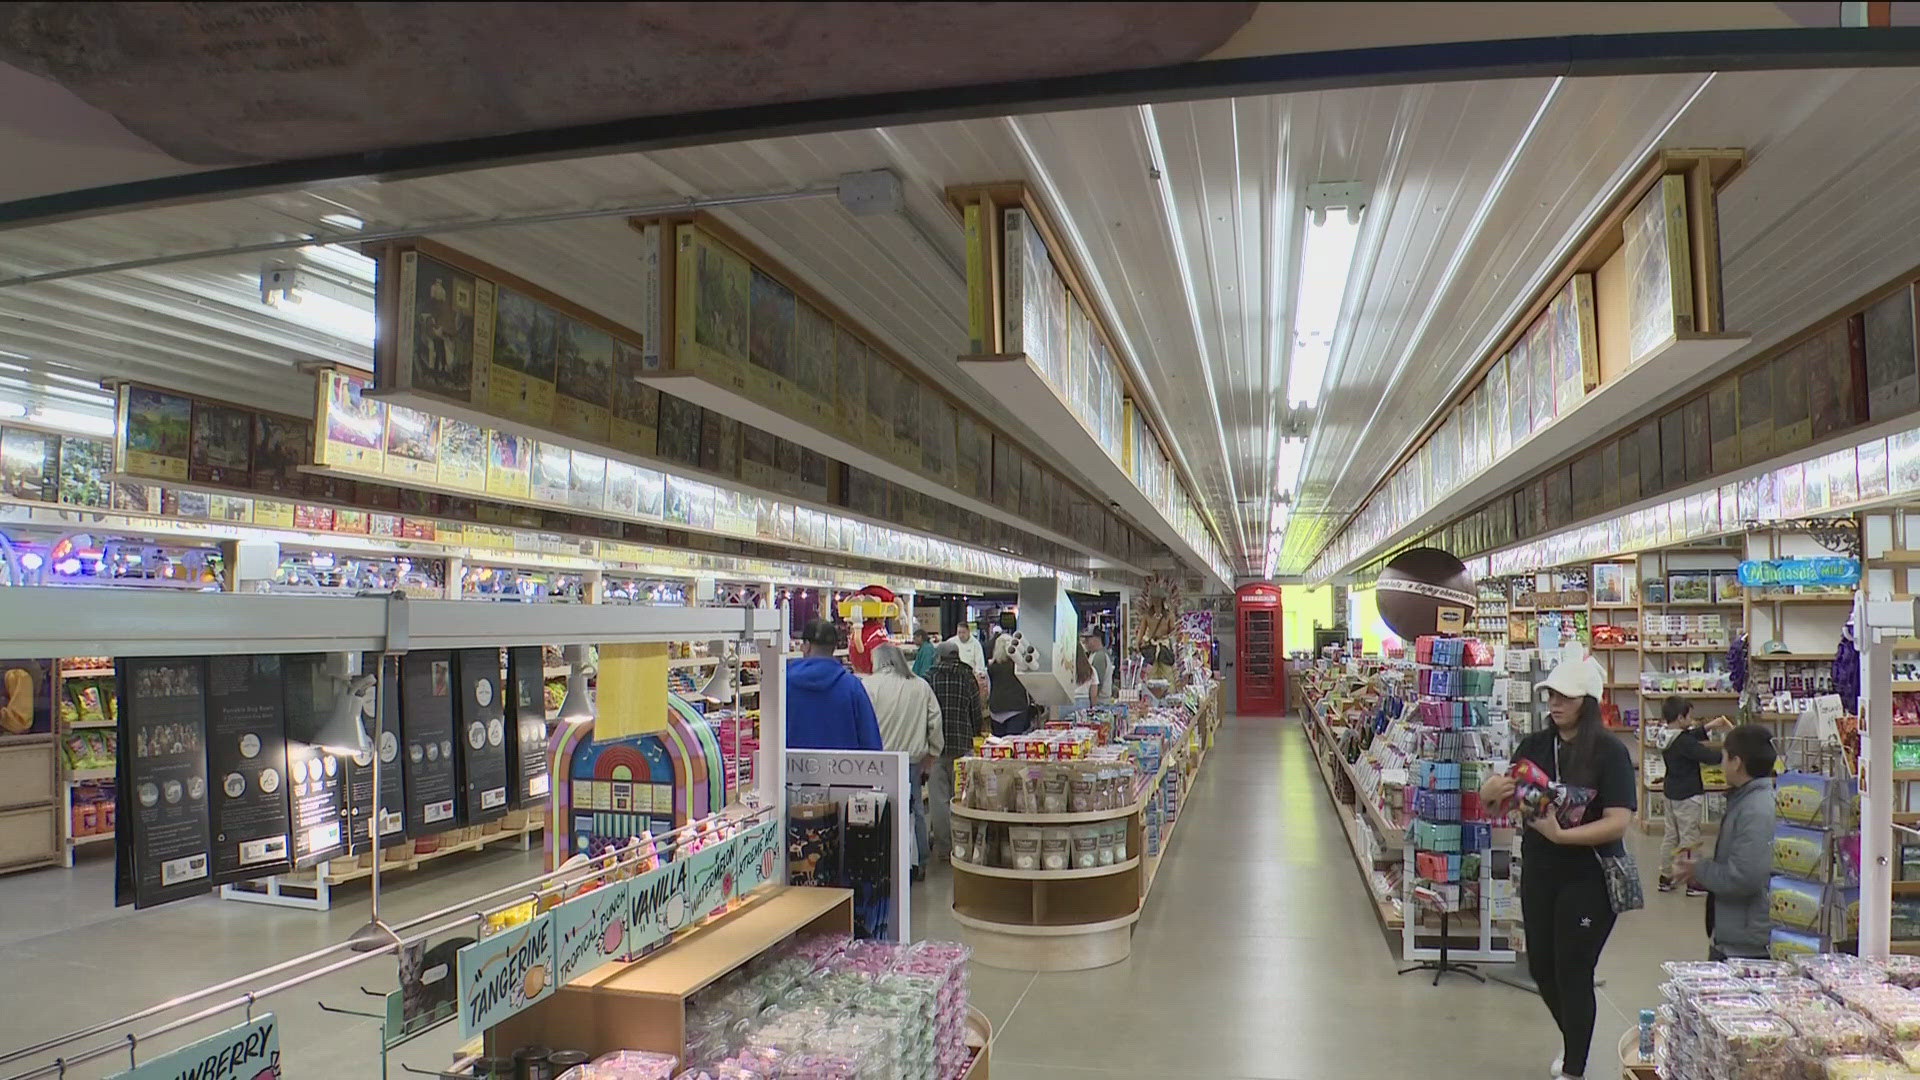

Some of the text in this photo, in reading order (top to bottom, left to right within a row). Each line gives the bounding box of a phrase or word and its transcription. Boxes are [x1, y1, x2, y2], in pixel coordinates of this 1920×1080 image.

[632, 861, 687, 927] VANILLA
[691, 841, 735, 916] WATERMELON
[560, 888, 626, 982] TROPICAL PUNCH
[470, 920, 549, 1027] TANGERINE
[174, 1024, 273, 1080] WBERRY
